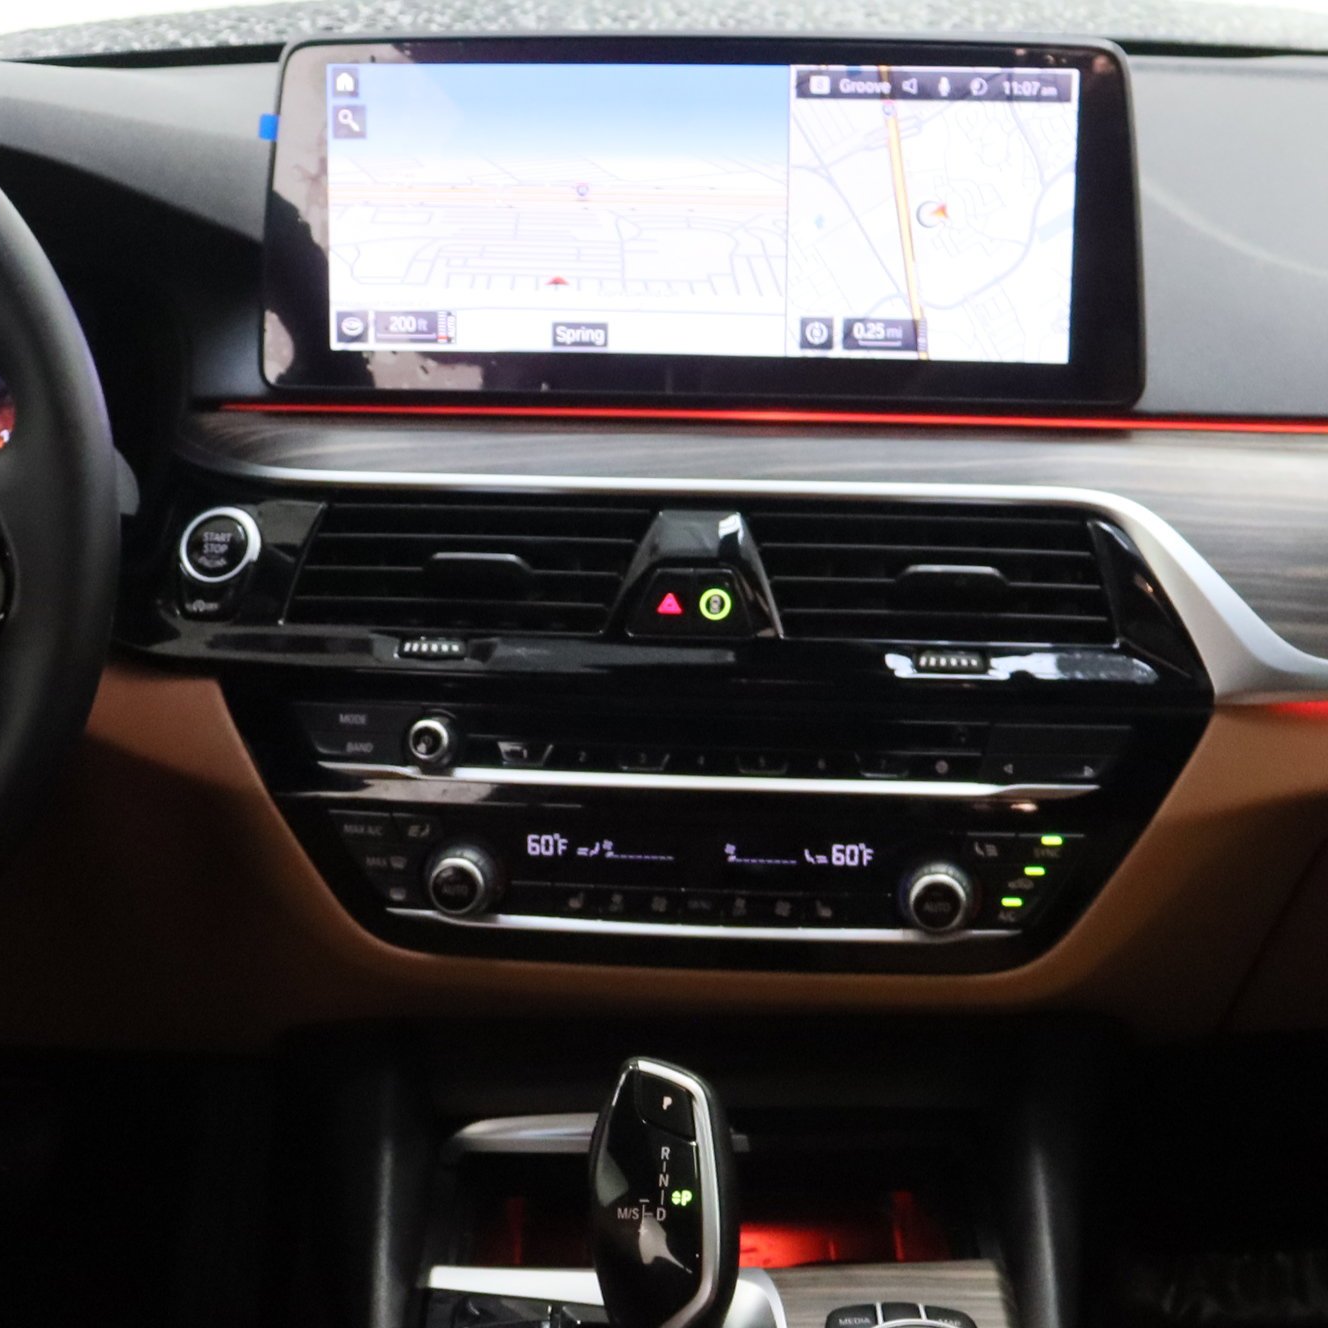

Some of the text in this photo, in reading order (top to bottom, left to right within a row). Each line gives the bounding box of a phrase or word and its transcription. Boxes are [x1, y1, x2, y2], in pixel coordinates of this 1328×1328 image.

[839, 78, 891, 94] Groove
[1002, 80, 1040, 96] 11:07
[389, 315, 416, 332] 200
[555, 325, 606, 346] Spring
[853, 321, 885, 340] 0.25
[203, 532, 232, 542] START
[203, 543, 228, 554] STOP
[338, 713, 367, 725] MODE
[345, 742, 374, 753] BAND
[526, 833, 568, 856] 60°F
[832, 843, 874, 867] 60°F
[662, 1096, 672, 1110] P
[660, 1147, 670, 1160] R
[659, 1174, 669, 1187] N
[681, 1190, 692, 1206] P
[617, 1207, 639, 1220] M/S
[656, 1208, 666, 1221] D
[838, 1317, 871, 1325] MEDIA
